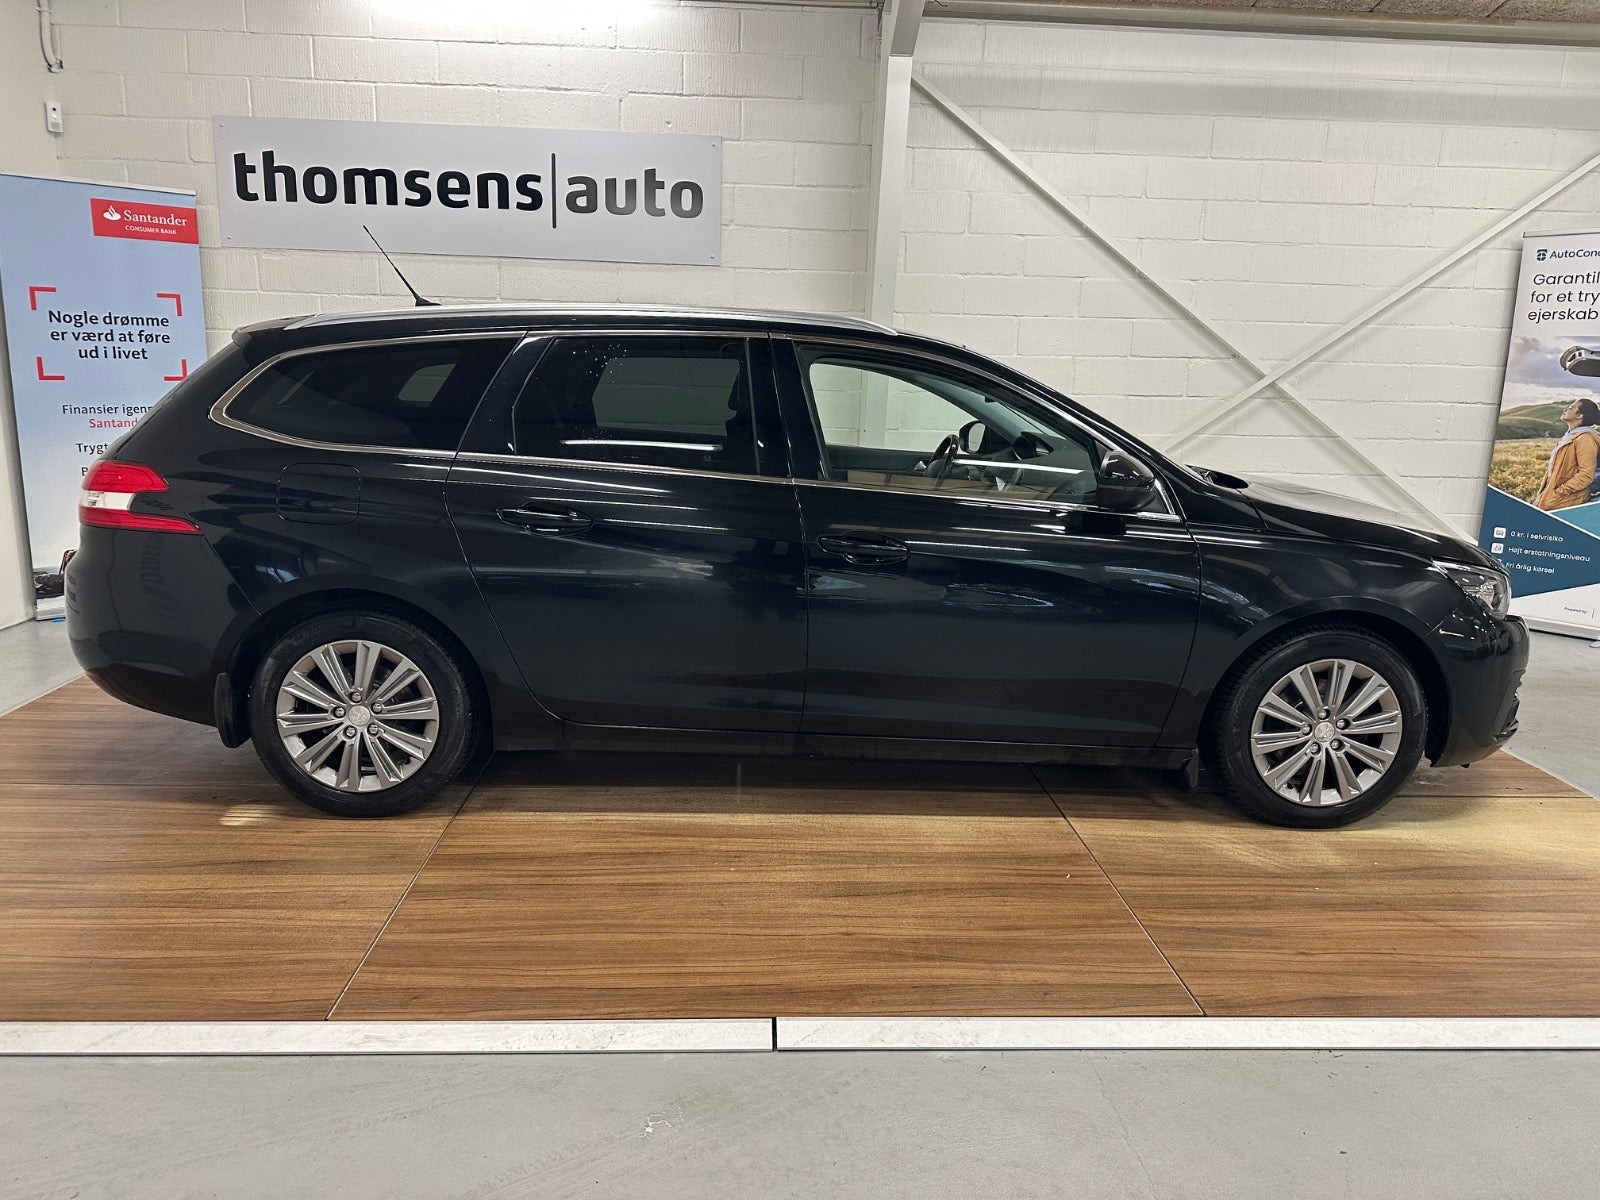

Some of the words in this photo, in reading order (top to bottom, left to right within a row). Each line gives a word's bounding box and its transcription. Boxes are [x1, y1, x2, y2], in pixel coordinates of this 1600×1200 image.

[233, 150, 543, 212] thomsens
[565, 168, 705, 219] auto
[123, 209, 187, 226] Santander
[125, 225, 159, 233] CONSUMER
[1531, 290, 1552, 303] for
[1556, 290, 1573, 303] et
[48, 310, 98, 328] Nogle
[102, 312, 169, 327] drømme
[1527, 308, 1599, 324] ejerskab
[50, 330, 67, 341] er
[71, 329, 115, 342] værd
[118, 331, 135, 342] at
[137, 330, 170, 344] føre
[78, 346, 99, 359] ud
[103, 346, 108, 359] i
[112, 346, 148, 360] livet
[62, 404, 119, 415] Finansier
